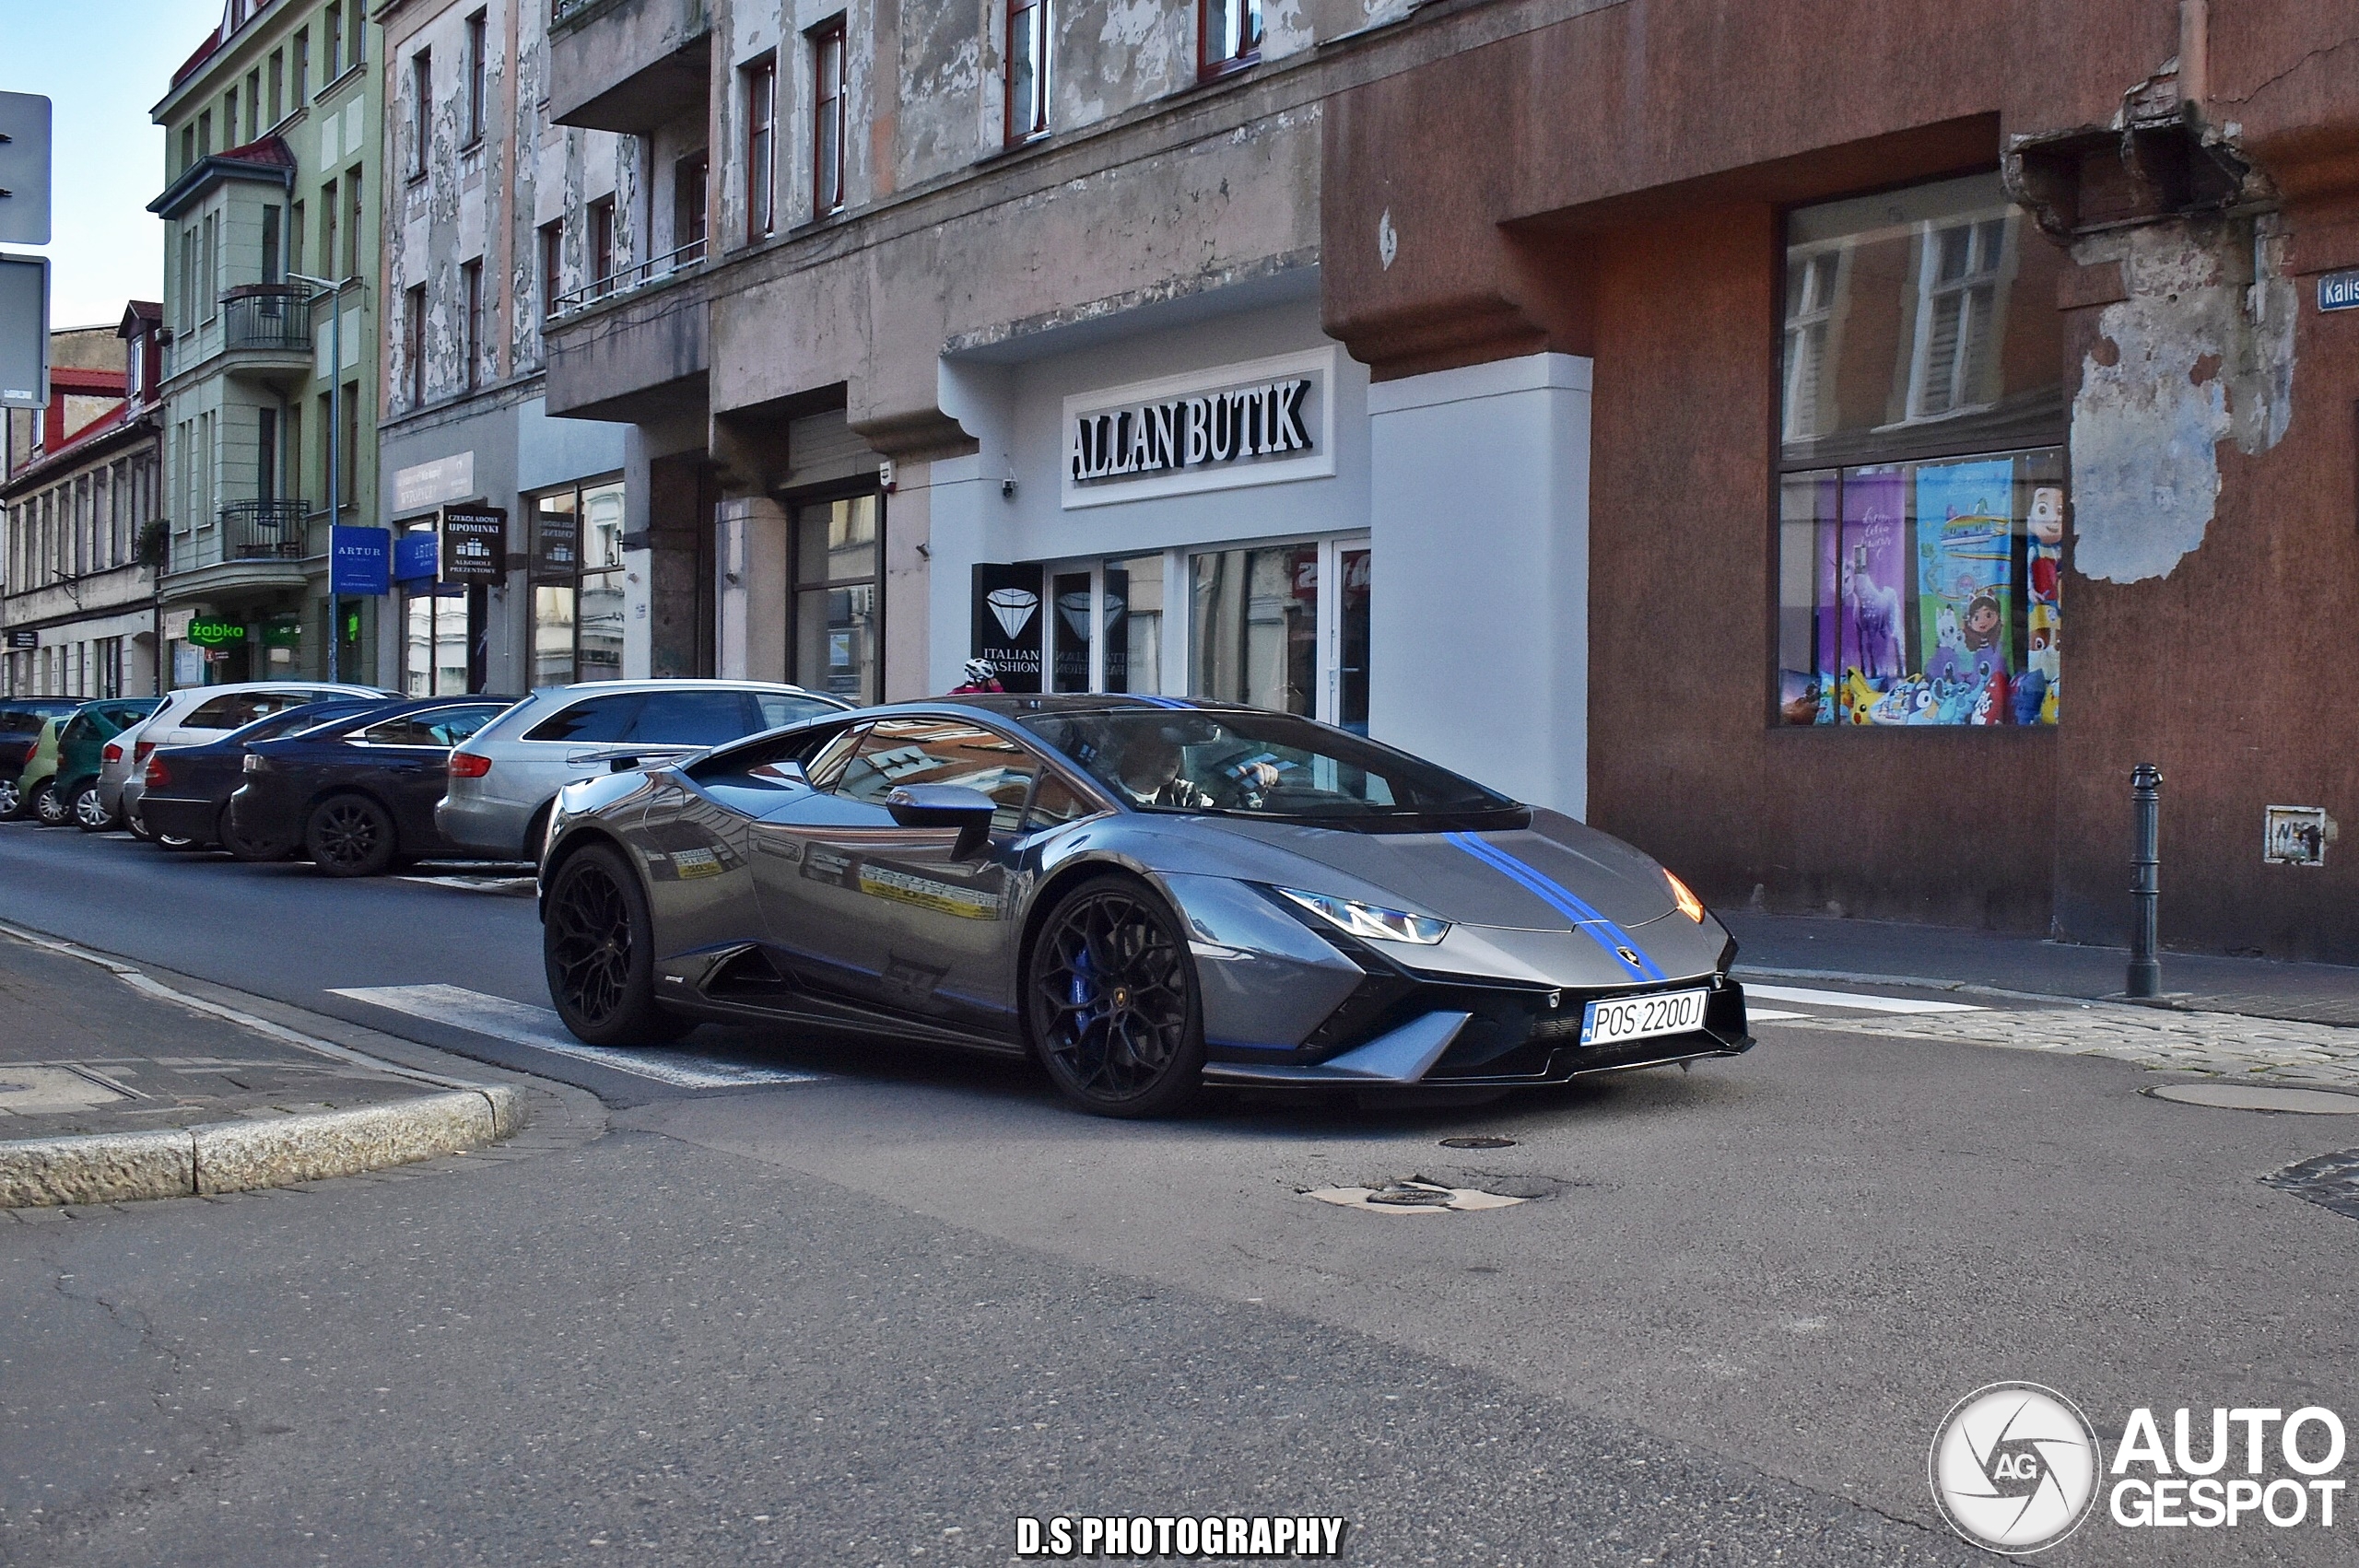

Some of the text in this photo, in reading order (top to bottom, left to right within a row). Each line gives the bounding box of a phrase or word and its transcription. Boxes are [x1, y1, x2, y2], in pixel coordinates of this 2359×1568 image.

[1071, 380, 1312, 480] ALLAN BUTIK
[449, 522, 499, 533] UPOMINKI
[338, 546, 381, 556] ARTUR
[193, 622, 244, 637] żabka
[984, 648, 1039, 661] ITALIAN
[1594, 994, 1702, 1039] POS 2200J
[1582, 1027, 1591, 1038] PL
